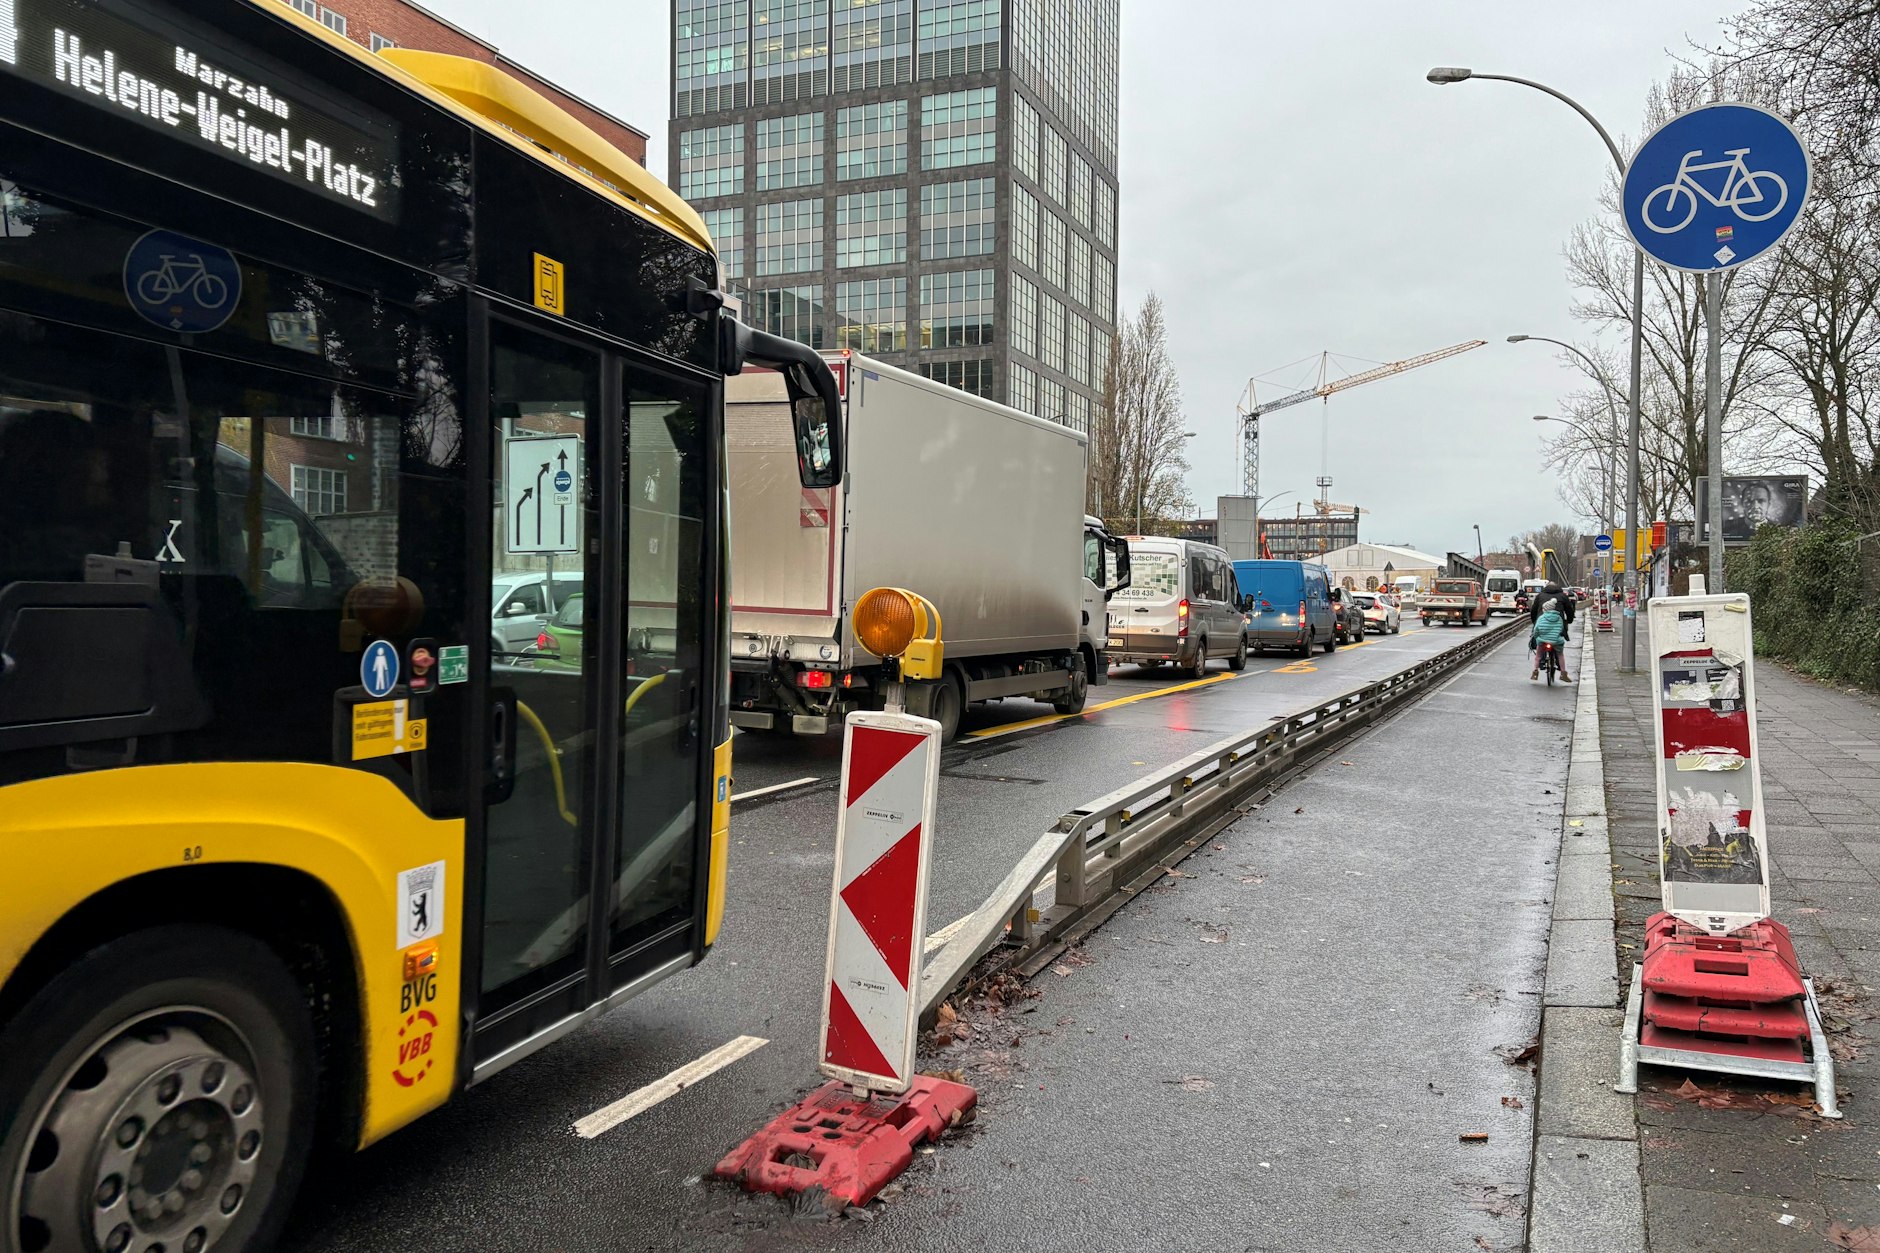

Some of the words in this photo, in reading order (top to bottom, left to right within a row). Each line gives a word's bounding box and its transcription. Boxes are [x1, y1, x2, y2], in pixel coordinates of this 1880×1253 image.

[175, 45, 290, 120] Marzahn
[54, 27, 376, 207] Helene-Weigel-Platz
[1129, 554, 1162, 562] Kutscher
[1141, 589, 1155, 597] 438
[400, 973, 437, 1014] BVG
[399, 1032, 433, 1066] VBB
